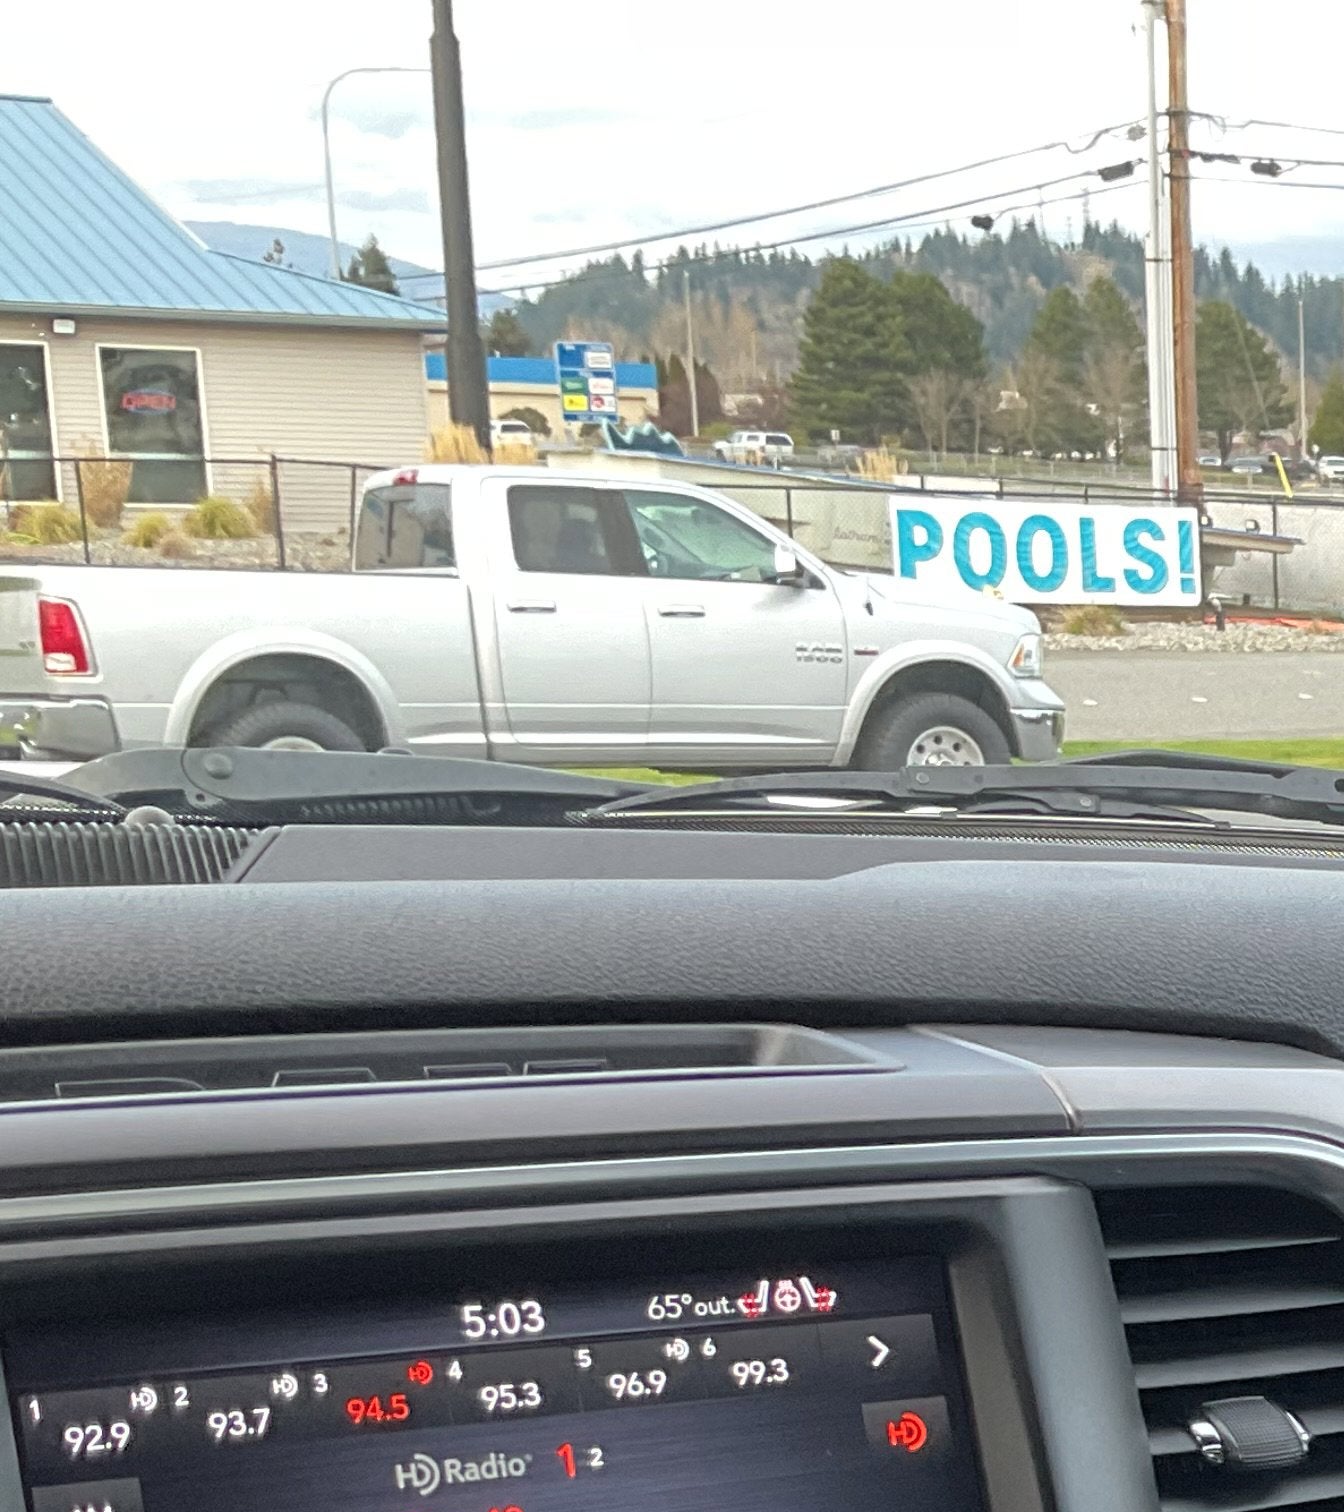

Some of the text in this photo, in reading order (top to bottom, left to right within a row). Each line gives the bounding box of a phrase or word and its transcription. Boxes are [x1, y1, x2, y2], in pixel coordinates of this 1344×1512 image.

[896, 509, 1197, 595] POOLS!
[462, 1301, 546, 1338] 5:03
[29, 1398, 41, 1422] 1
[174, 1387, 190, 1408] 2
[314, 1373, 329, 1394] 3
[446, 1360, 463, 1381] 4
[574, 1348, 592, 1369] 5
[701, 1338, 717, 1358] 6
[64, 1358, 789, 1454] 92.9 93.7 94.5 95.3 96.9 99.3
[444, 1453, 527, 1484] Radio
[556, 1442, 577, 1480] 1
[588, 1447, 606, 1468] 2
